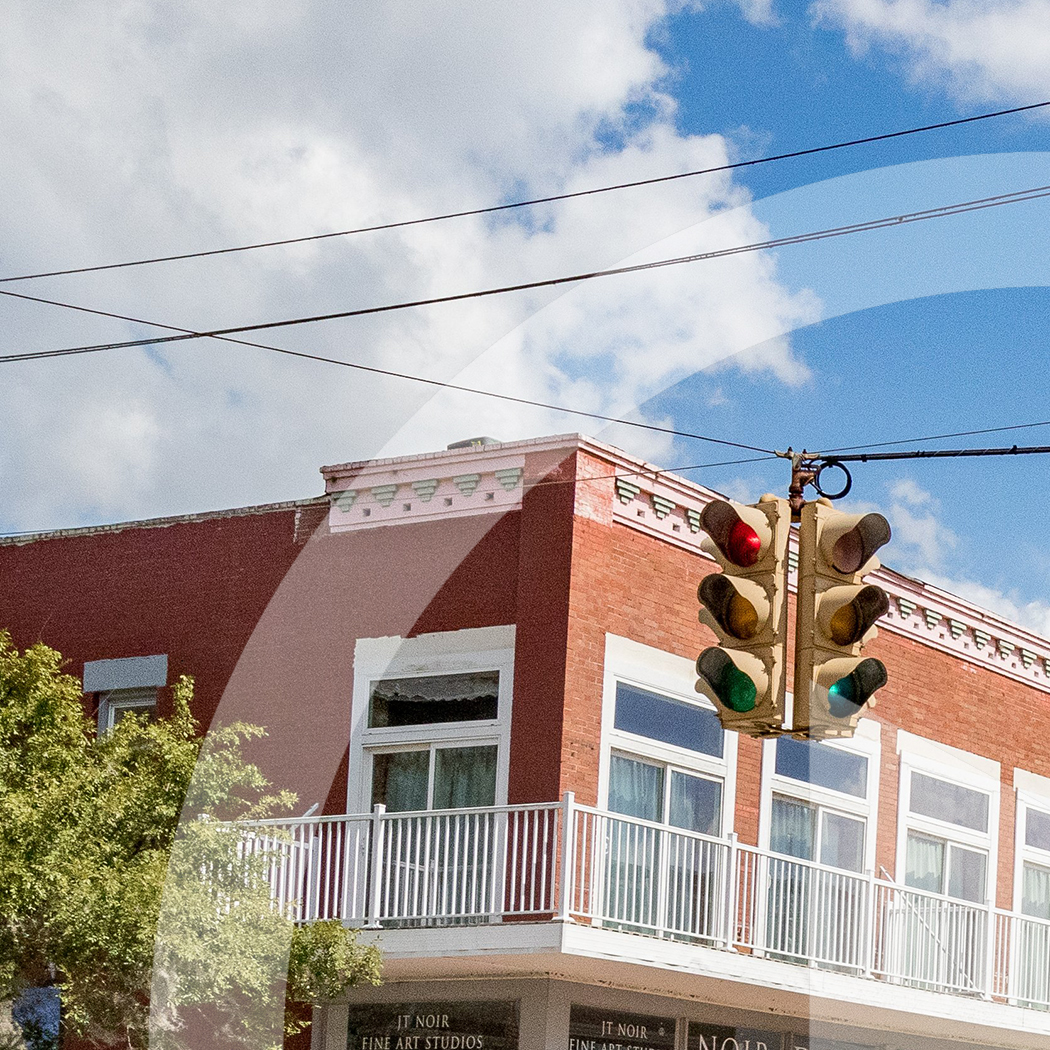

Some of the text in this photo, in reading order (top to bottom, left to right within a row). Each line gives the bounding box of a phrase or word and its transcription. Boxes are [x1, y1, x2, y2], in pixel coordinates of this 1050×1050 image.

[397, 1014, 450, 1031] JT NOIR
[601, 1020, 648, 1040] JT NOIR
[361, 1035, 483, 1050] FINE ART STUDIOS
